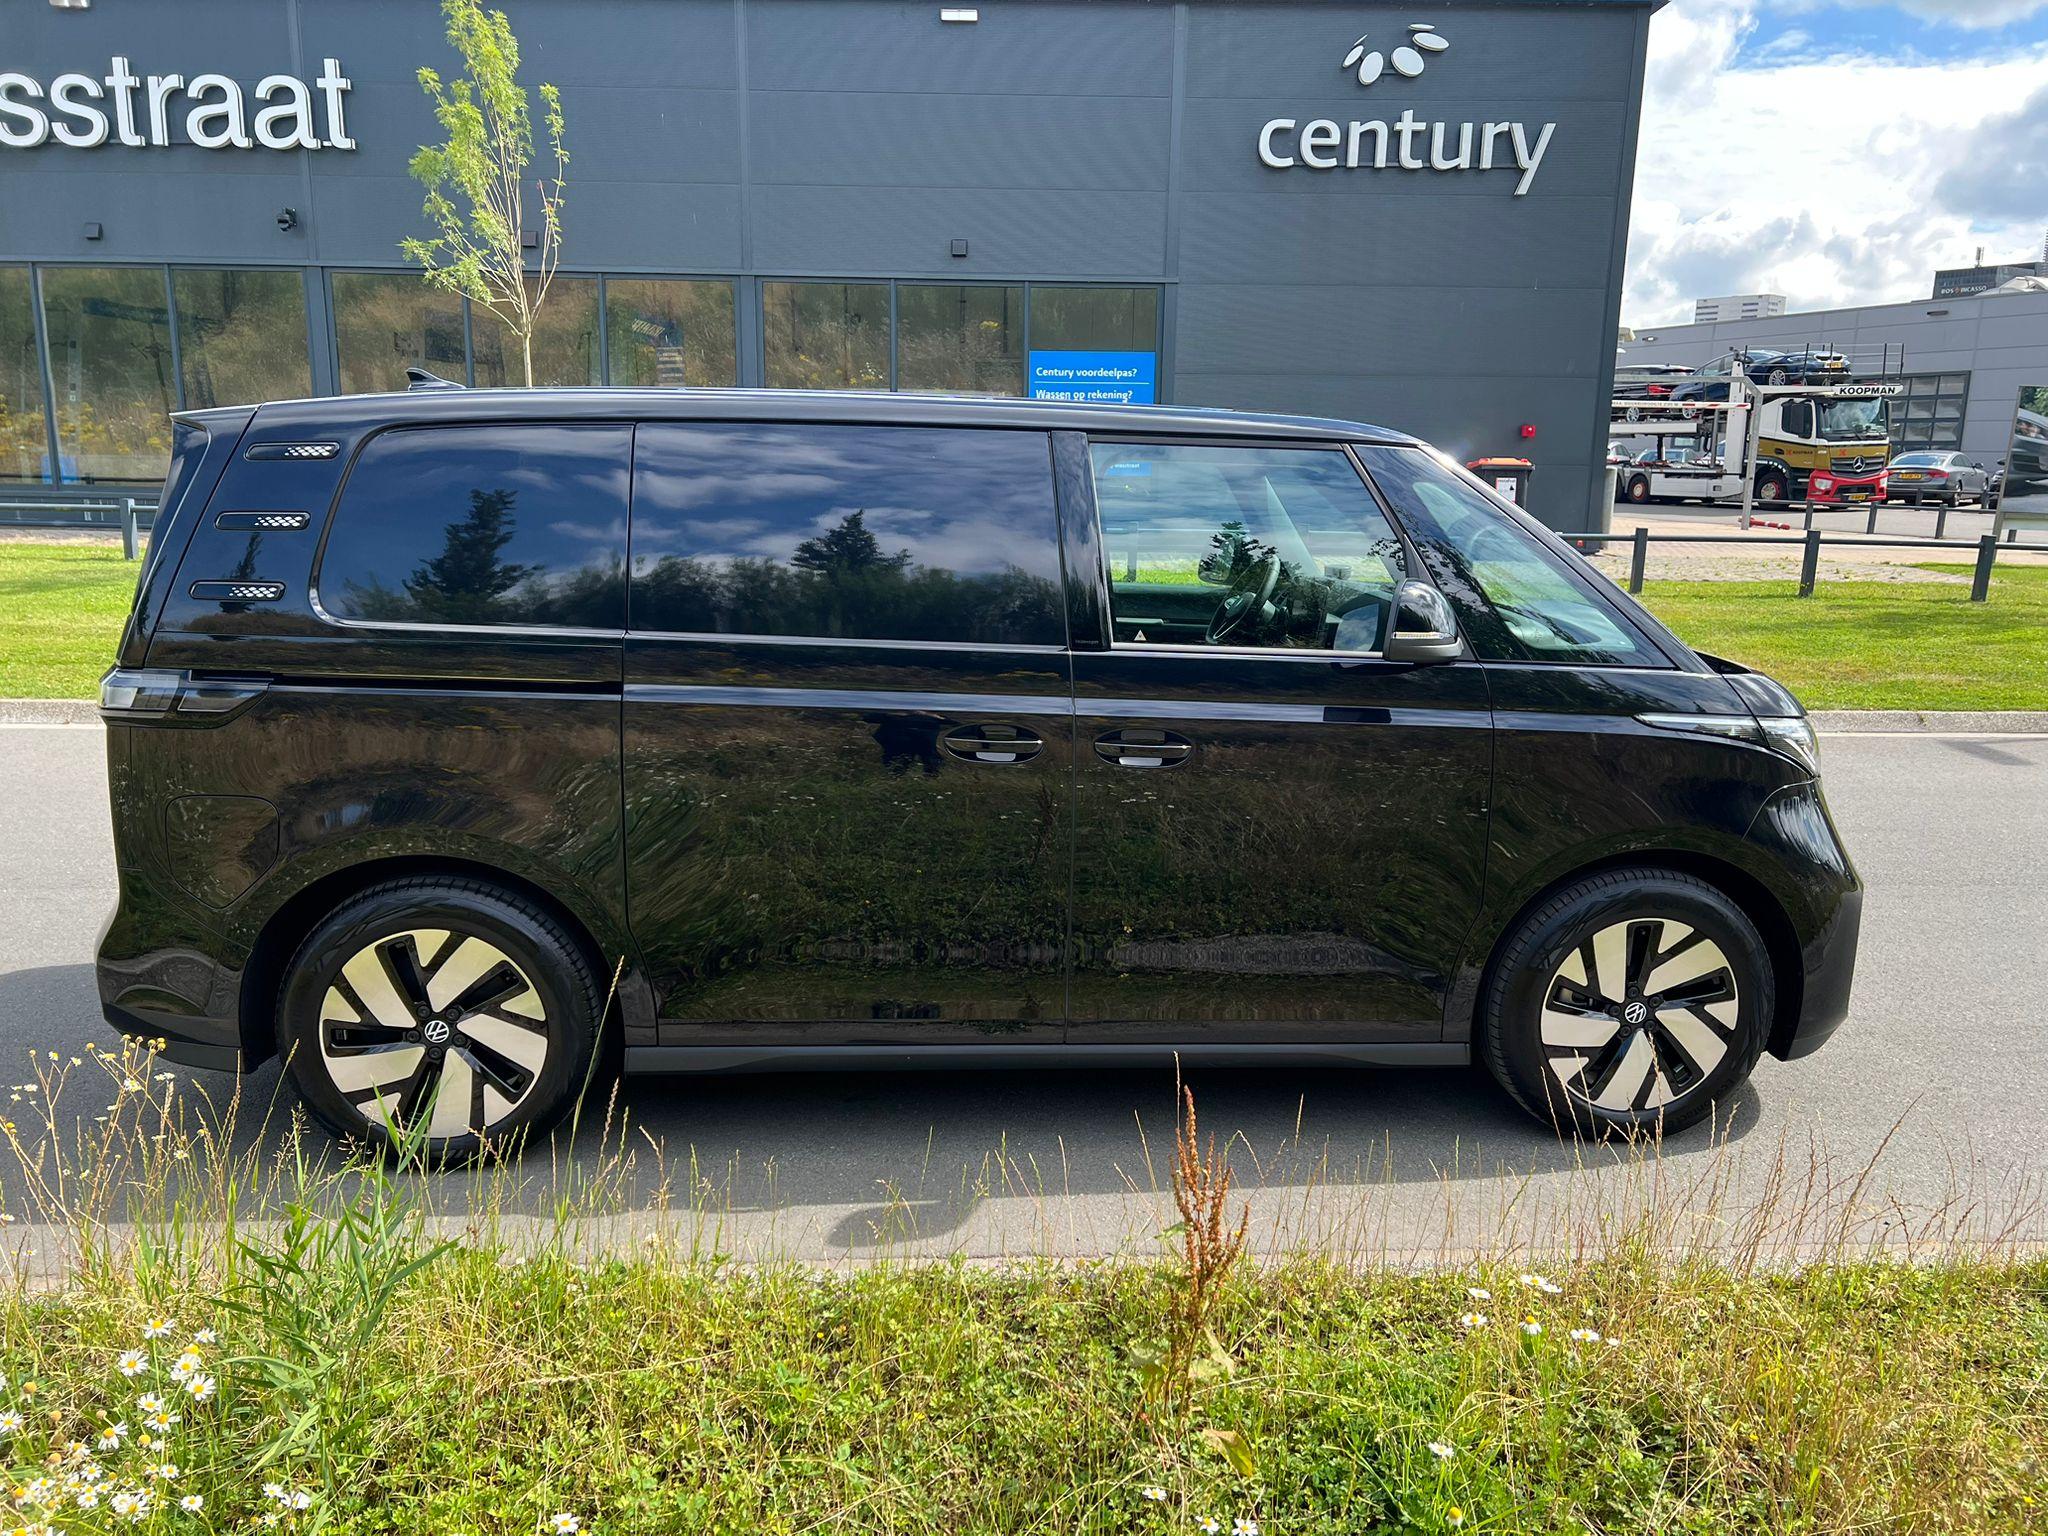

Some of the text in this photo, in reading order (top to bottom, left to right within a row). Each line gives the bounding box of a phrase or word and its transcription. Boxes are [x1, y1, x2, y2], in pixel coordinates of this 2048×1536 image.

[0, 55, 357, 150] sstraat
[1257, 108, 1557, 197] century
[1036, 367, 1138, 380] Century voordeelpas?
[1035, 389, 1132, 403] Wassen op rekening?
[1839, 386, 1896, 395] KOOPMAN
